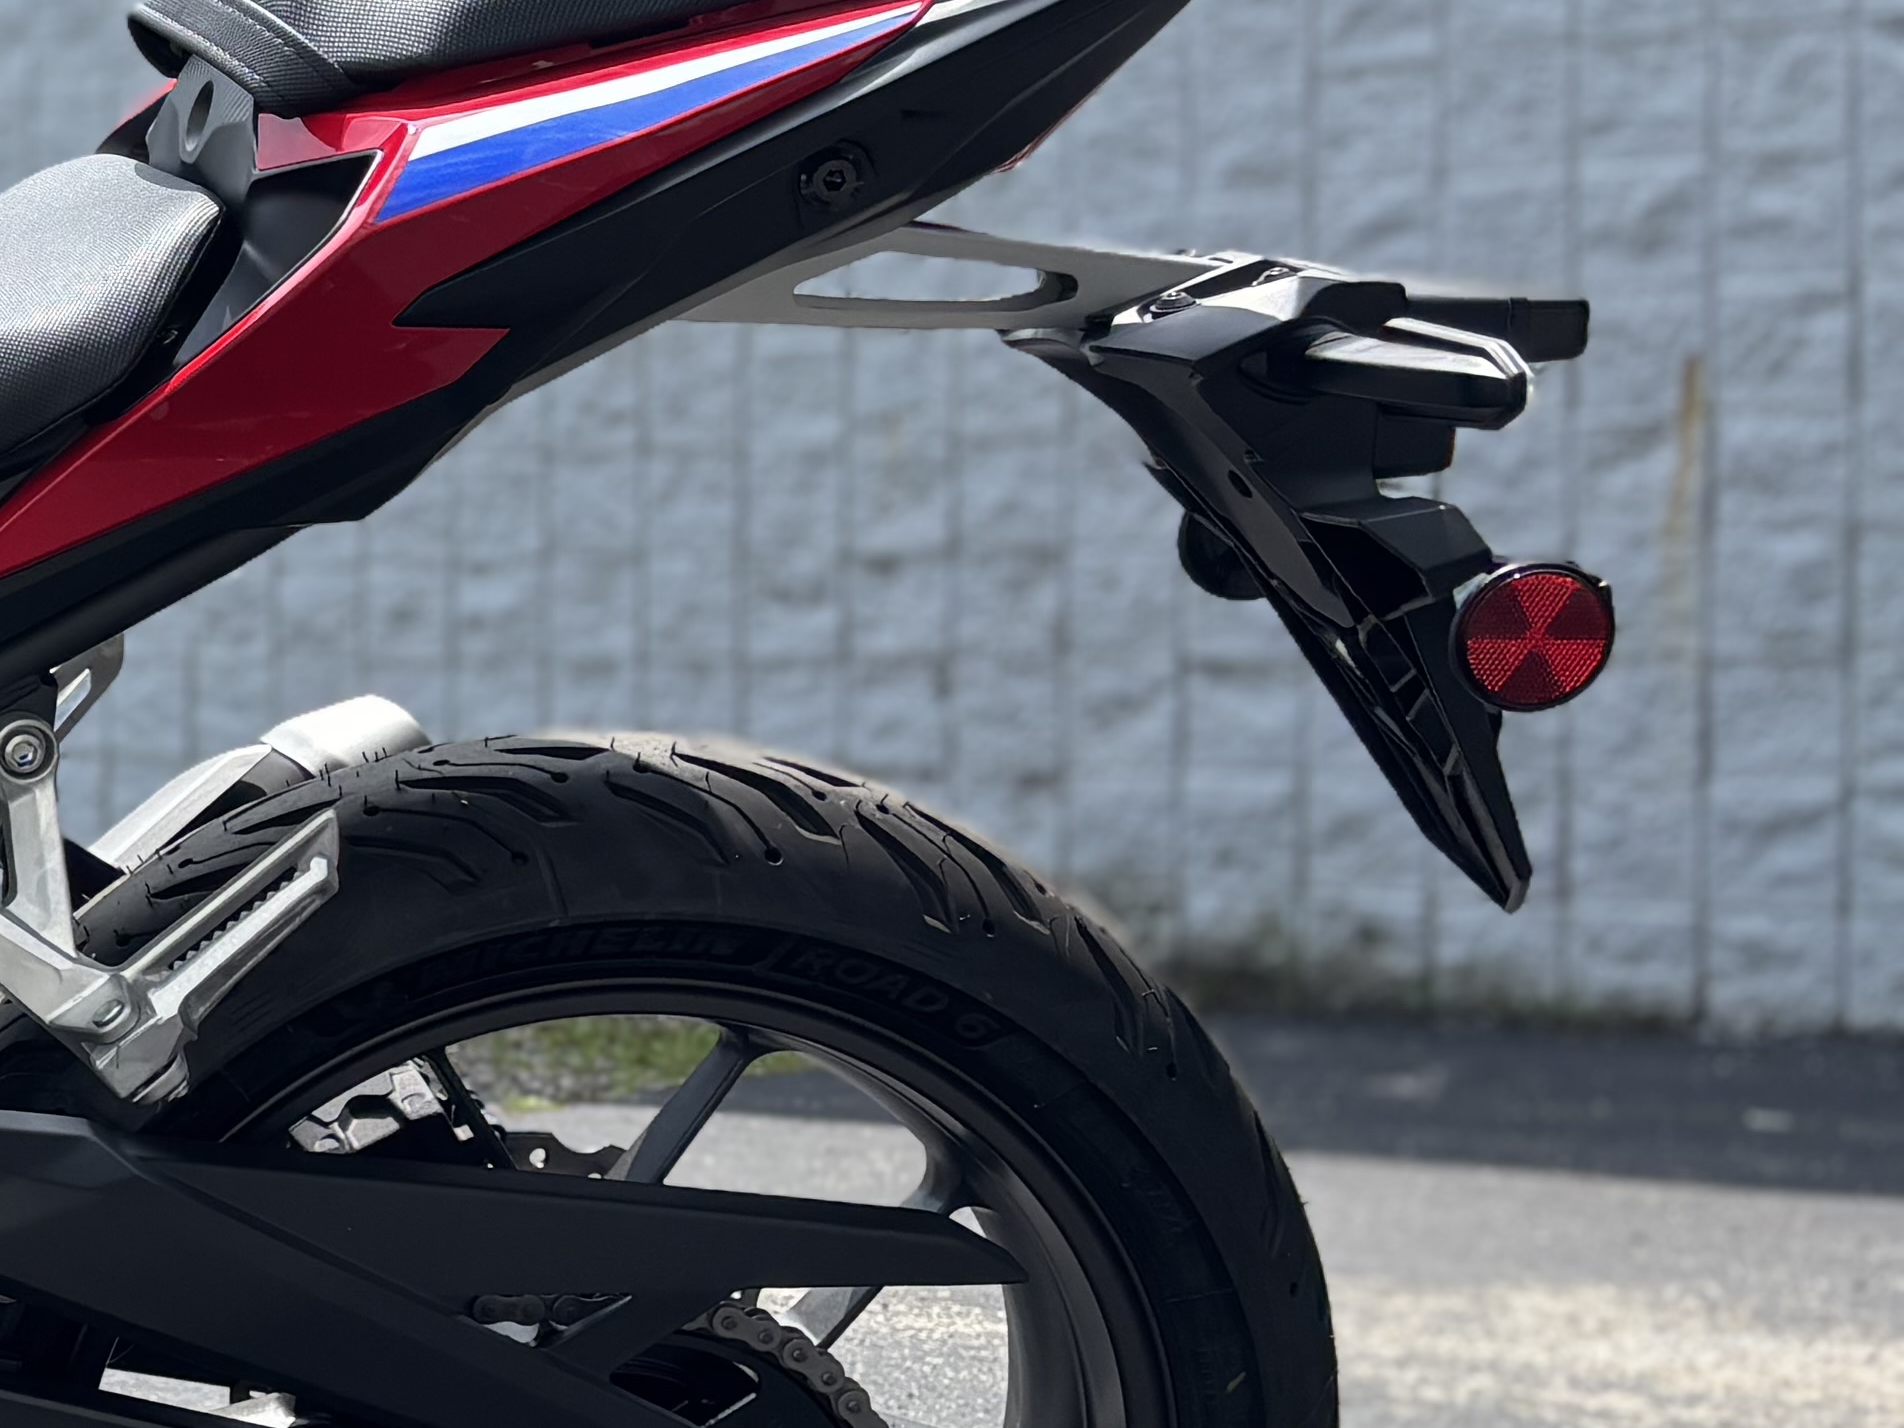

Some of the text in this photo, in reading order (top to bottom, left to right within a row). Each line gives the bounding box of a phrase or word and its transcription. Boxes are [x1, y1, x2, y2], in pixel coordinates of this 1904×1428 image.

[414, 926, 1000, 1046] MICHELIN ROAD 6
